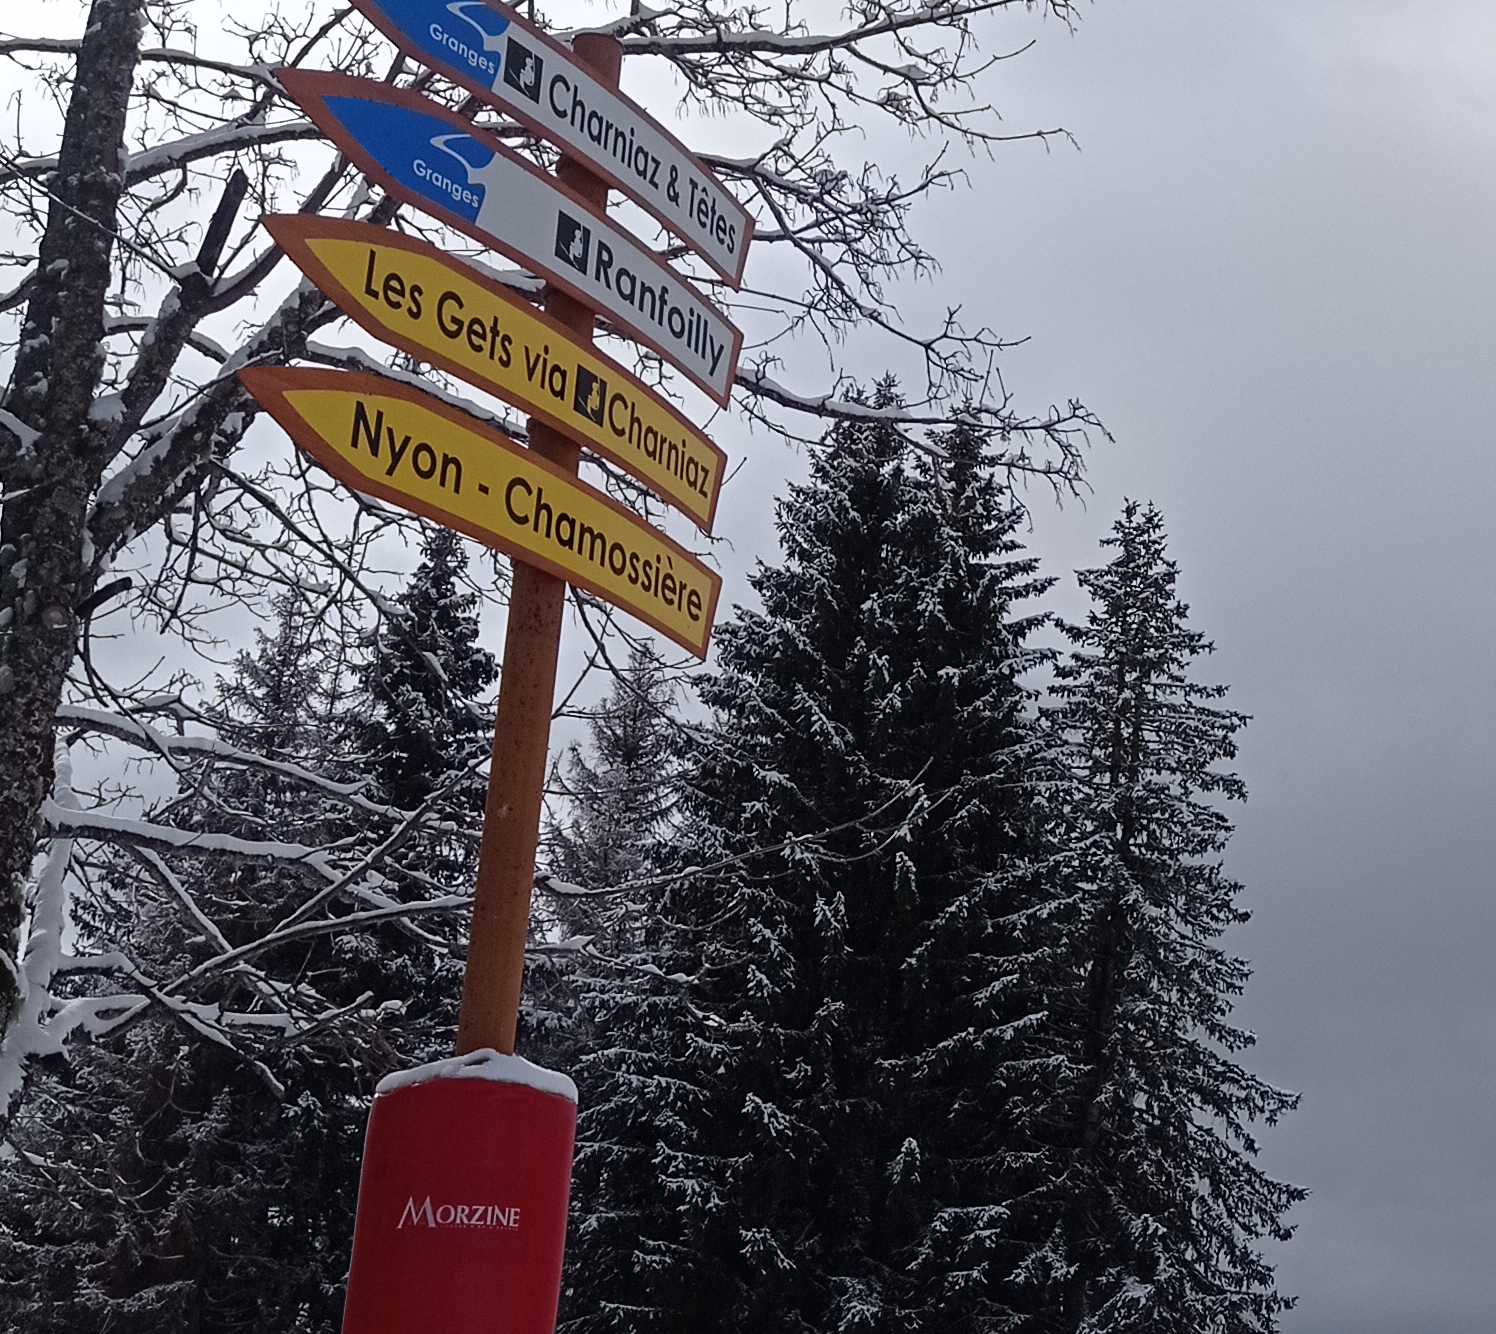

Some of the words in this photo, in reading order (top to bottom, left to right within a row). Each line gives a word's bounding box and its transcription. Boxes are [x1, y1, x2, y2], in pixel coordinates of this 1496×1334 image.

[428, 22, 496, 75] Granges
[412, 158, 479, 209] Granges
[548, 74, 660, 193] Charniaz
[666, 168, 680, 209] &
[687, 177, 737, 256] Têtes
[364, 249, 424, 321] Les
[436, 290, 513, 369] Gets
[524, 345, 567, 402] via
[608, 391, 710, 500] Charniaz
[594, 239, 726, 378] Ranfoilly
[350, 400, 463, 495] Nyon
[477, 483, 490, 497] -
[504, 476, 703, 622] Chamossière
[396, 1195, 521, 1229] MORZINE
